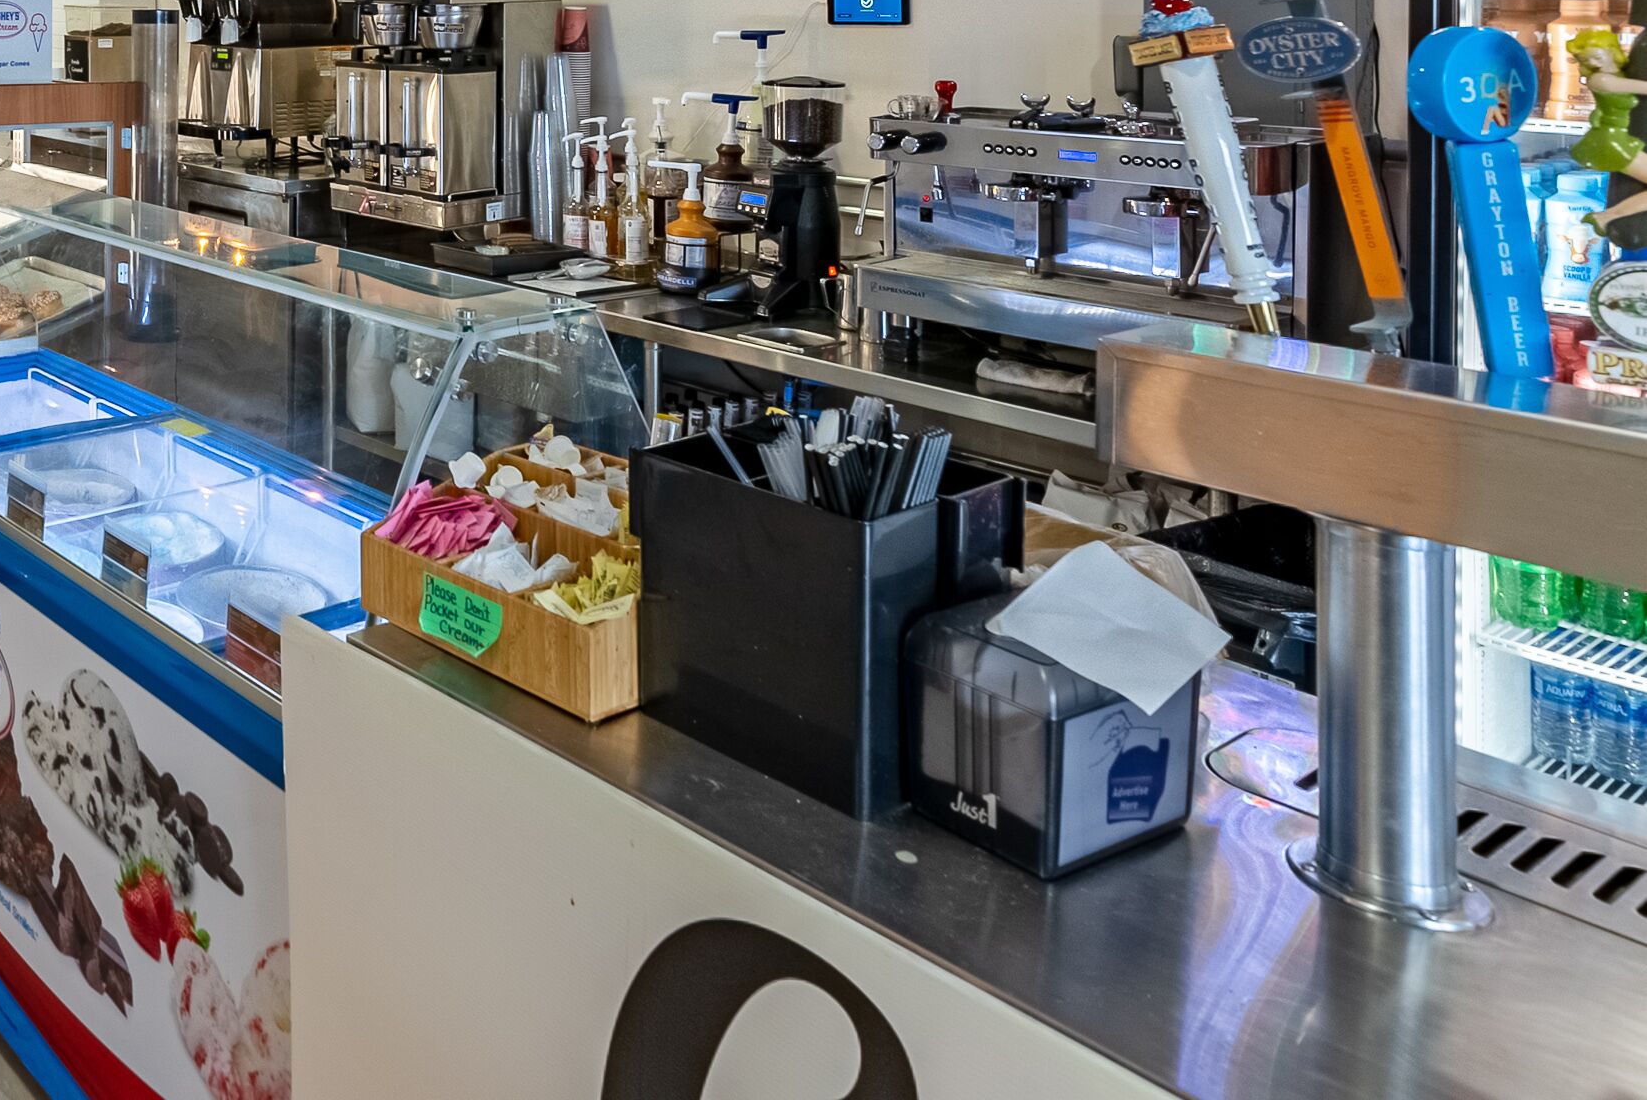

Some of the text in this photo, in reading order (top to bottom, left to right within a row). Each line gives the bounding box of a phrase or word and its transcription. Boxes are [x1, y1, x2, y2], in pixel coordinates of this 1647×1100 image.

[1248, 31, 1340, 55] OYSTER
[1270, 49, 1325, 69] CITY
[1341, 146, 1377, 249] MANGROVE MANGO
[1481, 152, 1529, 367] GRAYTON BEER
[1592, 350, 1647, 379] PR
[425, 574, 490, 621] Please Don't
[424, 593, 485, 636] Pocket our
[1545, 684, 1586, 698] AQUAFIN
[1112, 786, 1149, 798] Advertise
[1119, 801, 1139, 811] Here
